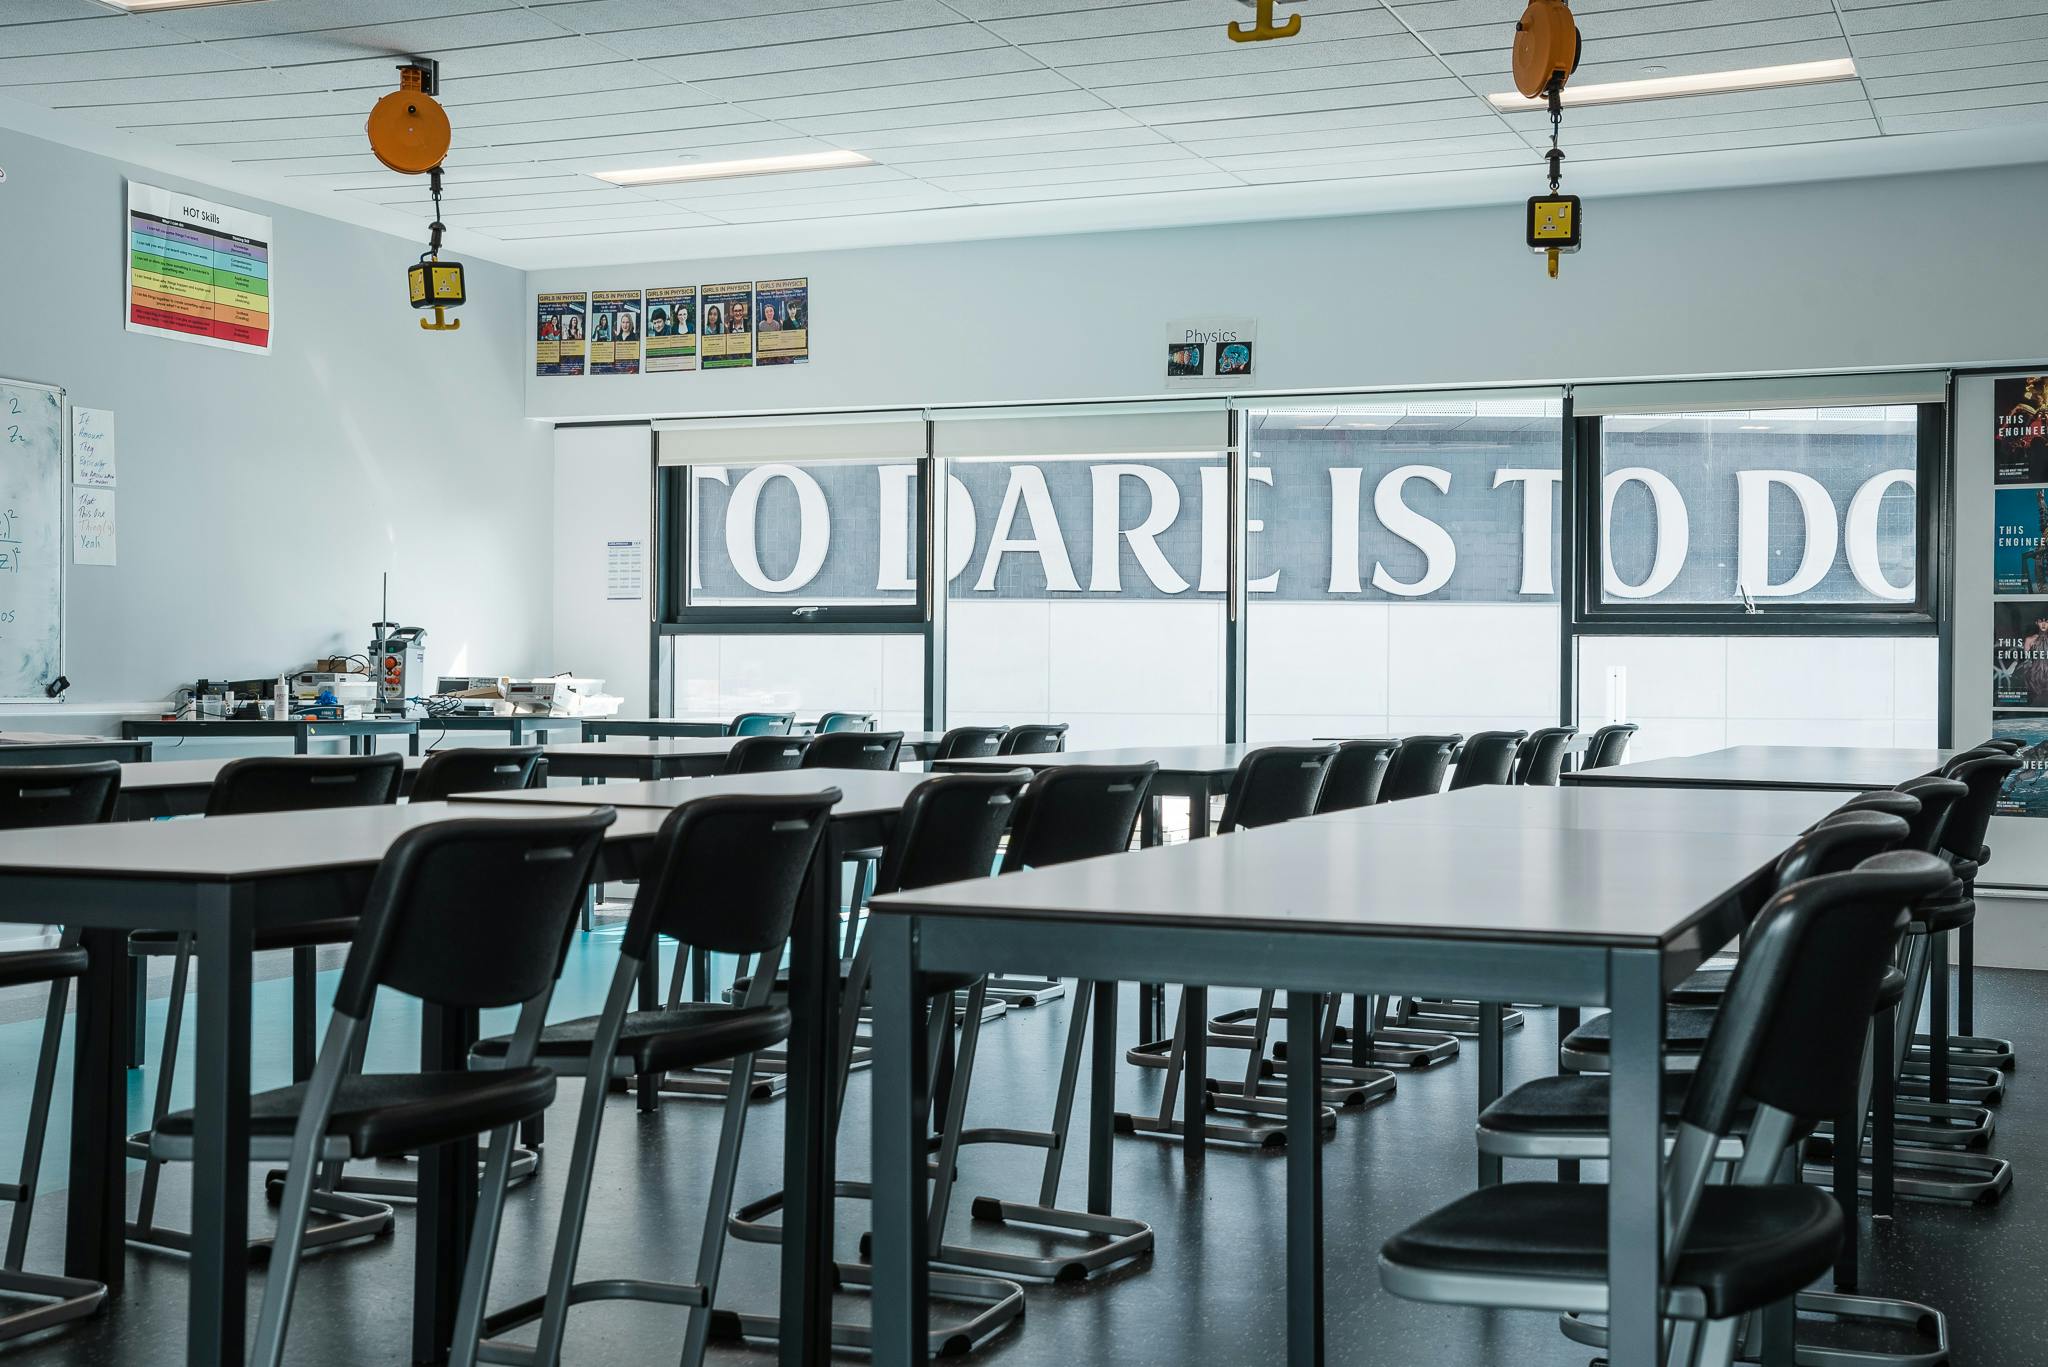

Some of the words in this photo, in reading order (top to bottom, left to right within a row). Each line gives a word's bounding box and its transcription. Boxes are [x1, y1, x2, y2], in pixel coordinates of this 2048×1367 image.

[183, 206, 200, 218] HOT
[201, 211, 220, 224] Skills
[670, 288, 694, 296] PHYSICS
[1185, 329, 1237, 345] Physics
[1999, 415, 2024, 425] THIS
[1999, 425, 2048, 437] ENGINEE
[876, 464, 1280, 595] DARE
[1328, 465, 1457, 597] IS
[1493, 467, 1689, 598] TO
[1735, 468, 1917, 600] DO
[1999, 525, 2024, 535] THIS
[1998, 638, 2023, 648] THIS
[1998, 650, 2048, 660] ENGINEE
